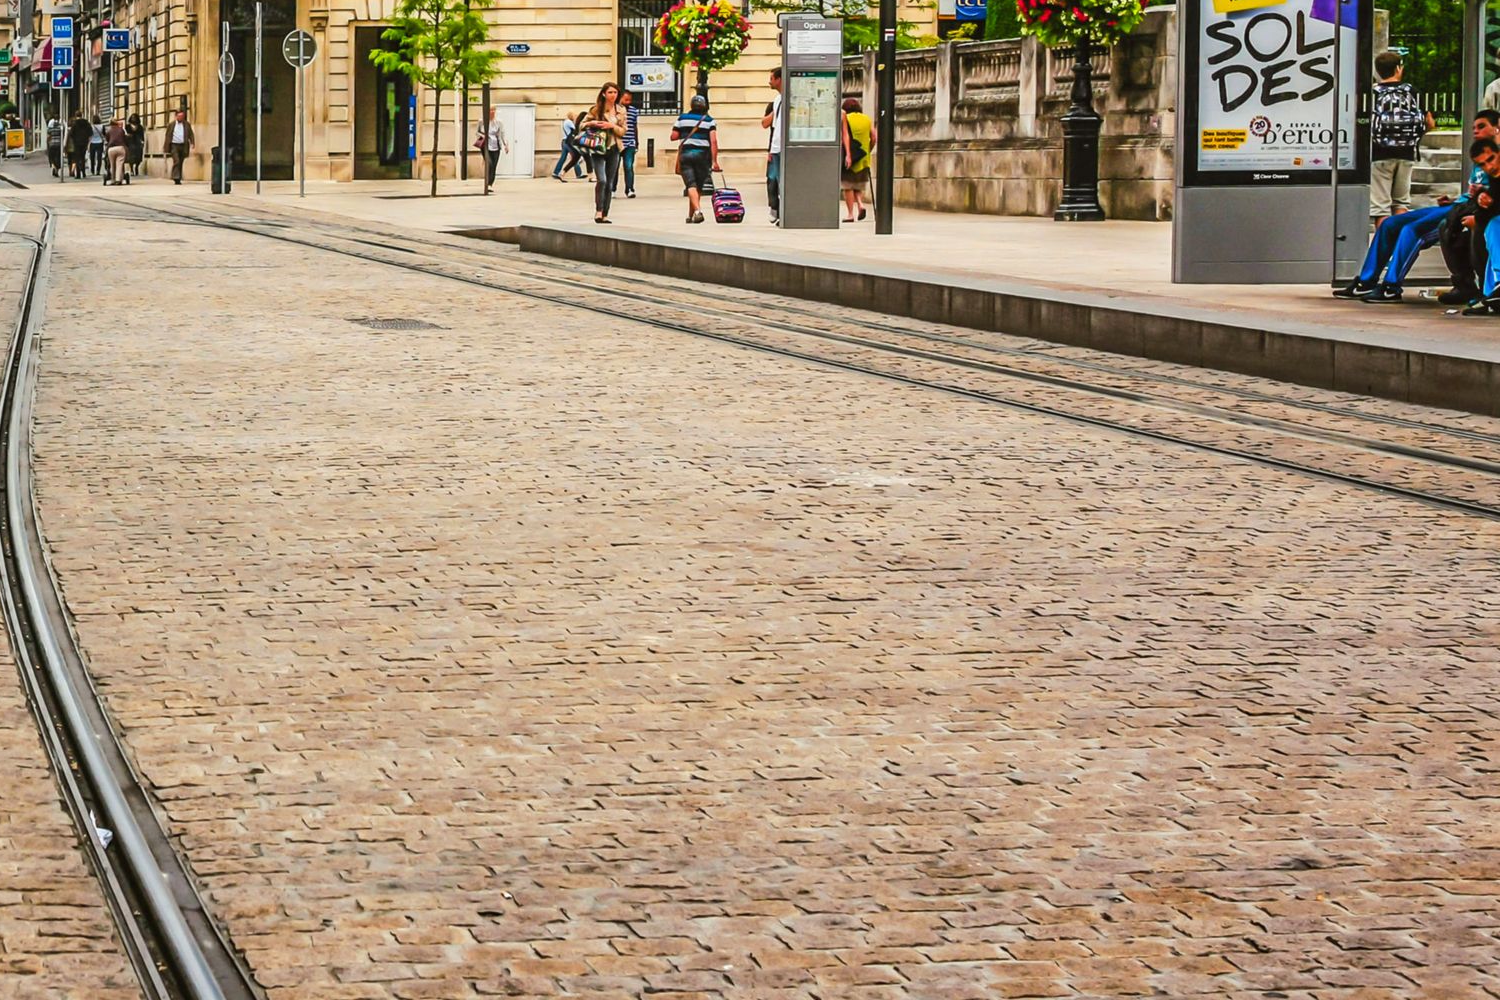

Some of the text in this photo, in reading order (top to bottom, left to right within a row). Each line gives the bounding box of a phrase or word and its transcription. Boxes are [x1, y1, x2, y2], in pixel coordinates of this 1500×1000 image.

[1206, 10, 1336, 66] SOL
[1211, 57, 1335, 113] DES
[1253, 120, 1266, 130] 20
